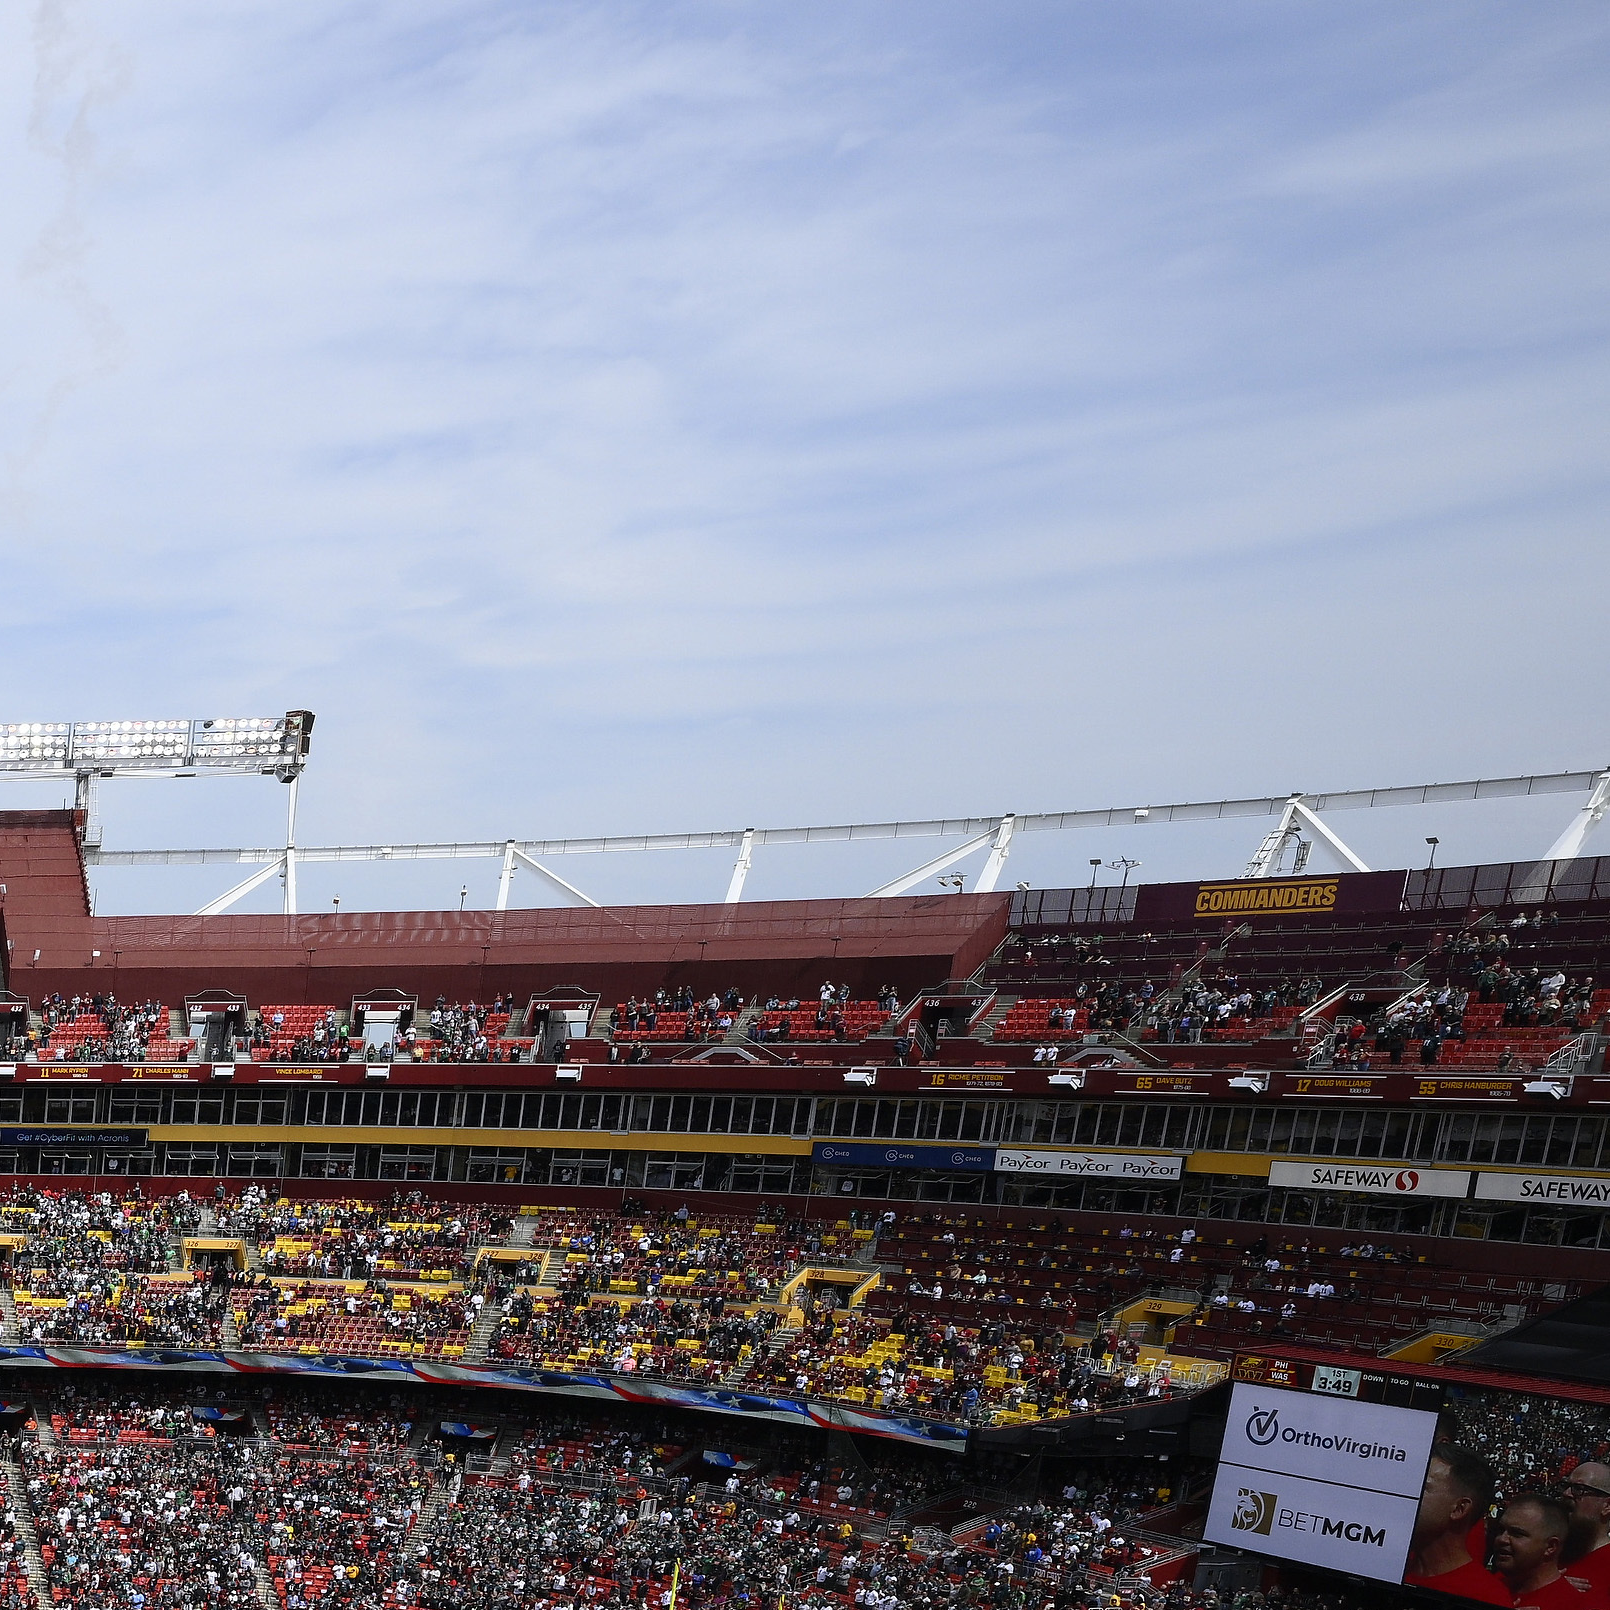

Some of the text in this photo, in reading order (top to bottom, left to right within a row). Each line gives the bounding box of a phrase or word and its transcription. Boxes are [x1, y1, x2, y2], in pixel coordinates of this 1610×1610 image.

[1196, 885, 1337, 911] COMMANDERS
[578, 1003, 592, 1011] 435
[924, 998, 940, 1007] 436
[132, 1067, 143, 1078] 71
[1136, 1077, 1153, 1090] 65
[1296, 1079, 1311, 1092] 17
[1419, 1081, 1436, 1095] 55
[17, 1133, 32, 1142] Get
[78, 1133, 95, 1142] with
[97, 1133, 129, 1142] Acronis
[1000, 1155, 1178, 1177] Paycor Paycor Paycor
[1311, 1169, 1394, 1187] SAFEWAY
[1520, 1180, 1610, 1201] SAFEWAY
[1146, 1302, 1162, 1311] 329
[1274, 1361, 1348, 1378] PHI 1ST
[1270, 1371, 1289, 1381] WAS
[1318, 1377, 1352, 1394] 3:49
[1363, 1374, 1384, 1384] DOWN
[1400, 1379, 1409, 1387] GO
[1416, 1381, 1429, 1390] BALL
[1281, 1426, 1407, 1462] OrthoVirginia
[1277, 1509, 1386, 1548] BETMGM
